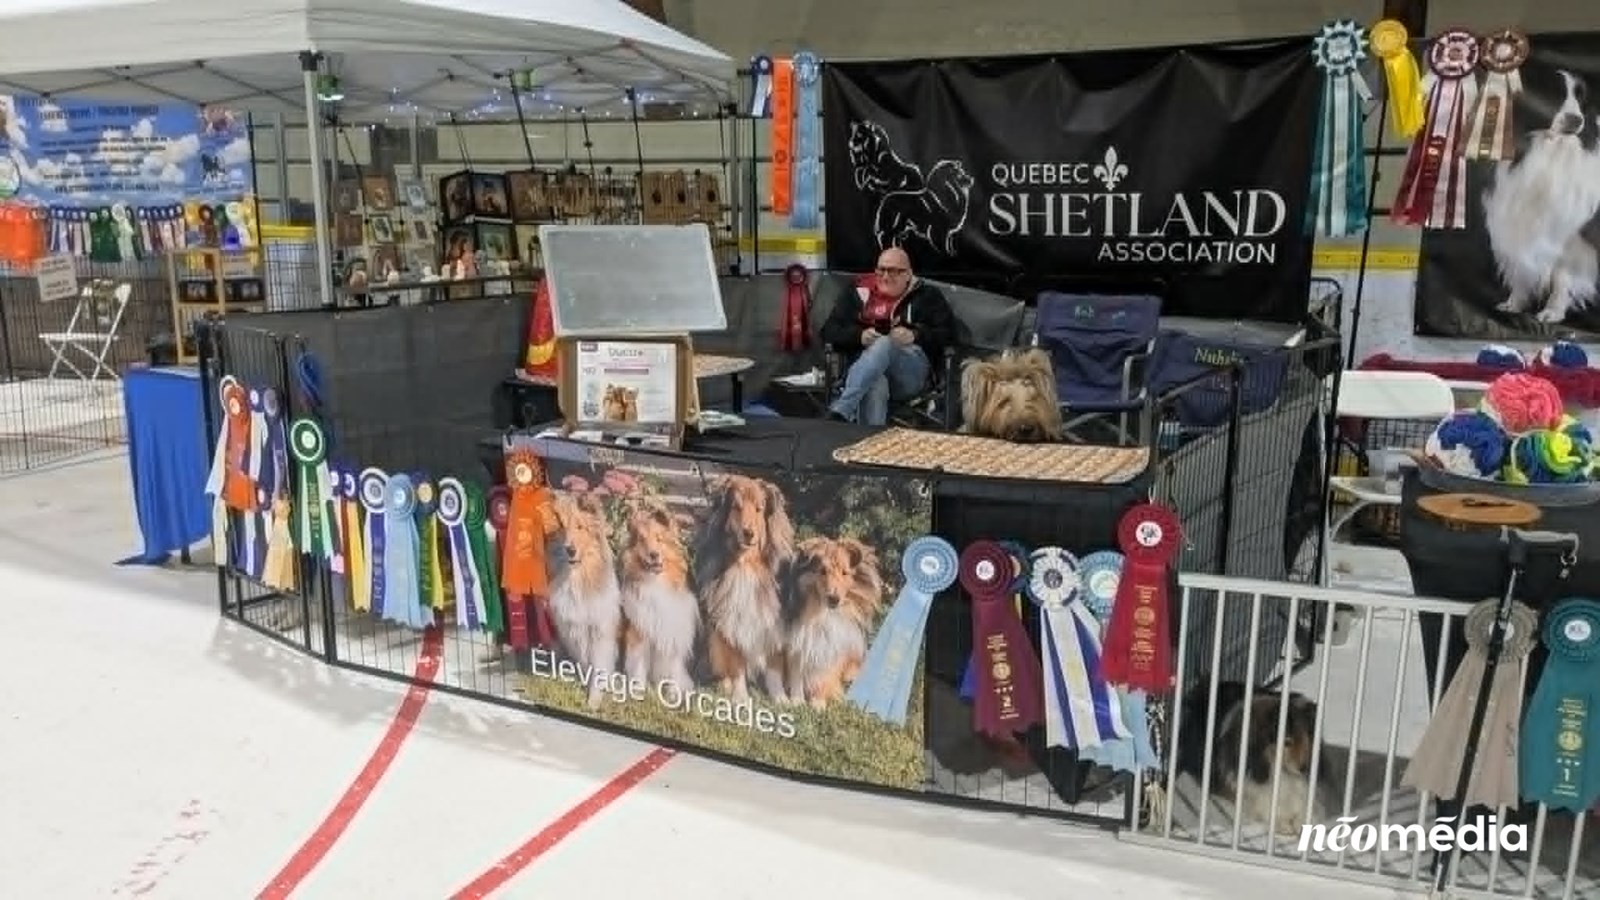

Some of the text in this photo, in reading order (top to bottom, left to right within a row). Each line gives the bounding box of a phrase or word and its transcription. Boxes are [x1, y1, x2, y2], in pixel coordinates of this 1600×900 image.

[991, 163, 1090, 186] QUEBEC
[988, 188, 1286, 238] SHETLAND
[1097, 240, 1276, 264] ASSOCIATION
[530, 643, 796, 738] Élevage Orcades
